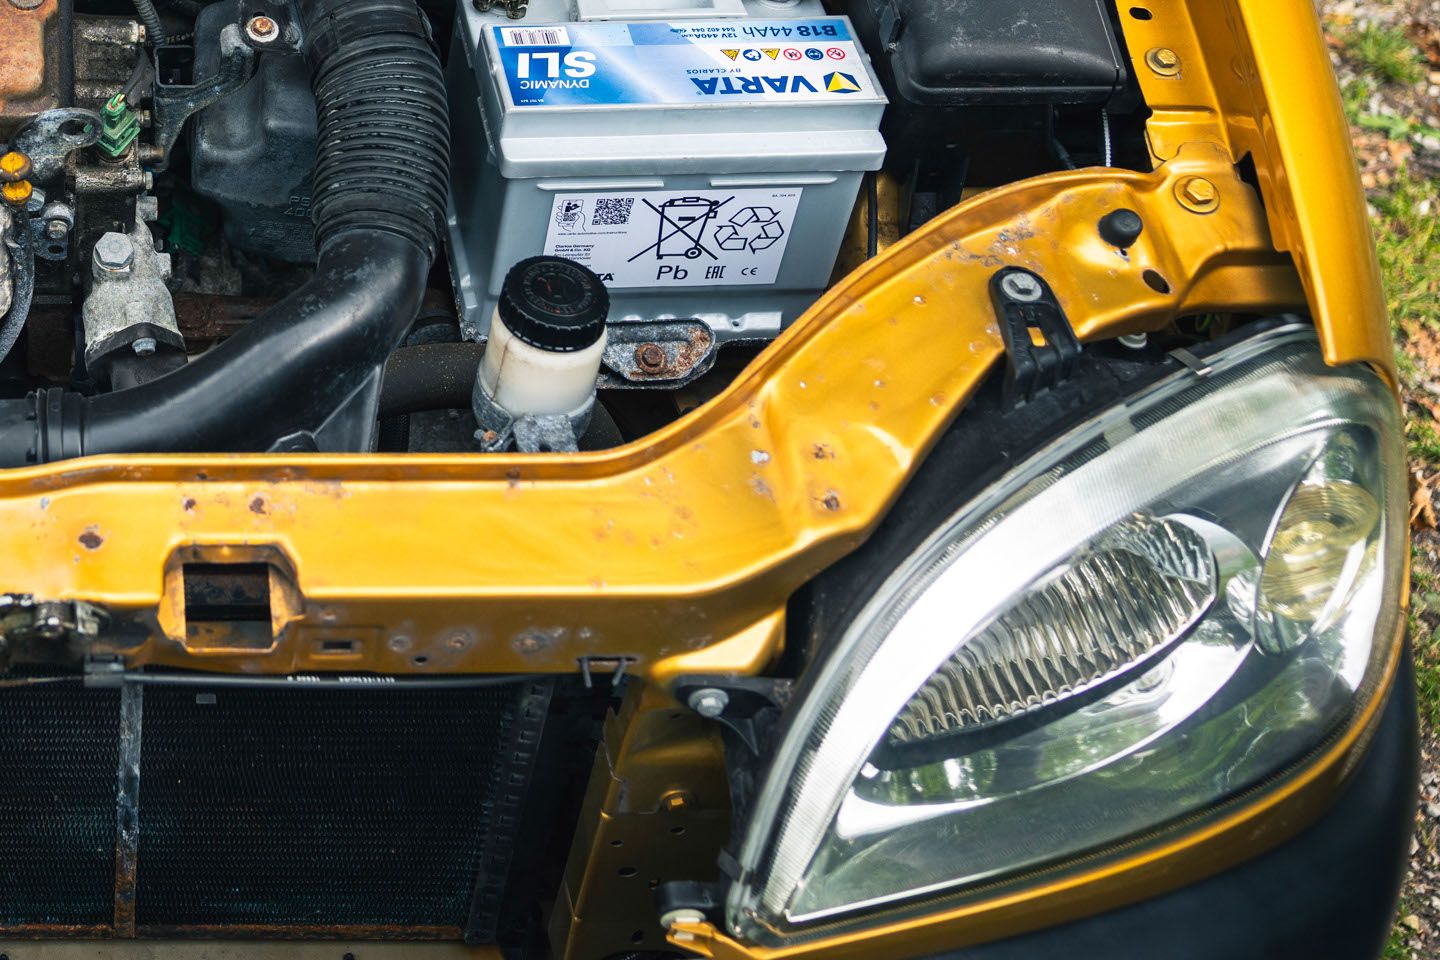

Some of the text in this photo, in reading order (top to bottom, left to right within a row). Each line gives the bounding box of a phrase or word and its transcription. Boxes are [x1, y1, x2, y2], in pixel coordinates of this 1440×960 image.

[742, 25, 838, 38] B18 44Ah
[517, 51, 597, 78] SLI
[520, 79, 589, 89] DYNAMIC
[690, 75, 819, 95] VARTA
[656, 265, 689, 280] Pb
